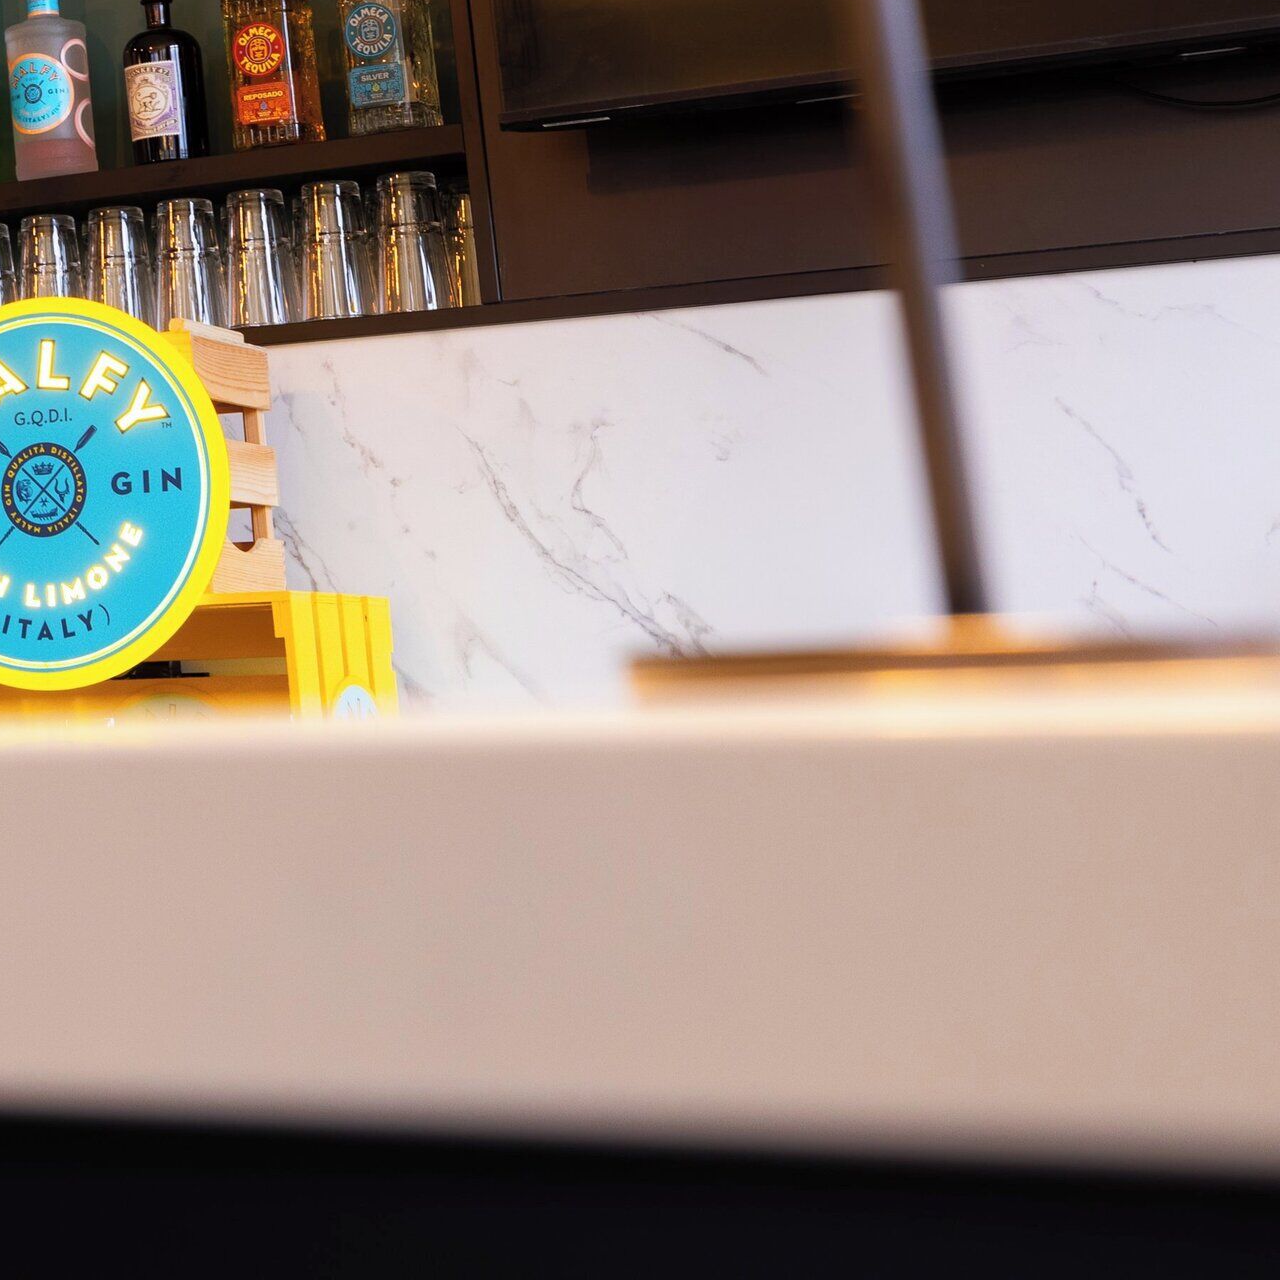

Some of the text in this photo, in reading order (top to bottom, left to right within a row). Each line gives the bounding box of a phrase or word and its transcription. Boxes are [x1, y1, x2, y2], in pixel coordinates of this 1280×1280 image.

[349, 6, 389, 28] OLMECA
[238, 26, 278, 47] OLMECA
[352, 33, 393, 55] TEQUILA
[240, 52, 281, 74] TEQUILA
[13, 61, 62, 89] MALFY
[361, 71, 390, 83] SILVER
[243, 90, 284, 102] REPOSADO
[14, 406, 73, 428] G.Q.D.I.
[5, 444, 84, 533] GIN QUALITÀ DISTILLATO ITALIA
[111, 467, 184, 496] GIN
[10, 511, 42, 534] MALFY
[24, 521, 144, 608] LIMONE
